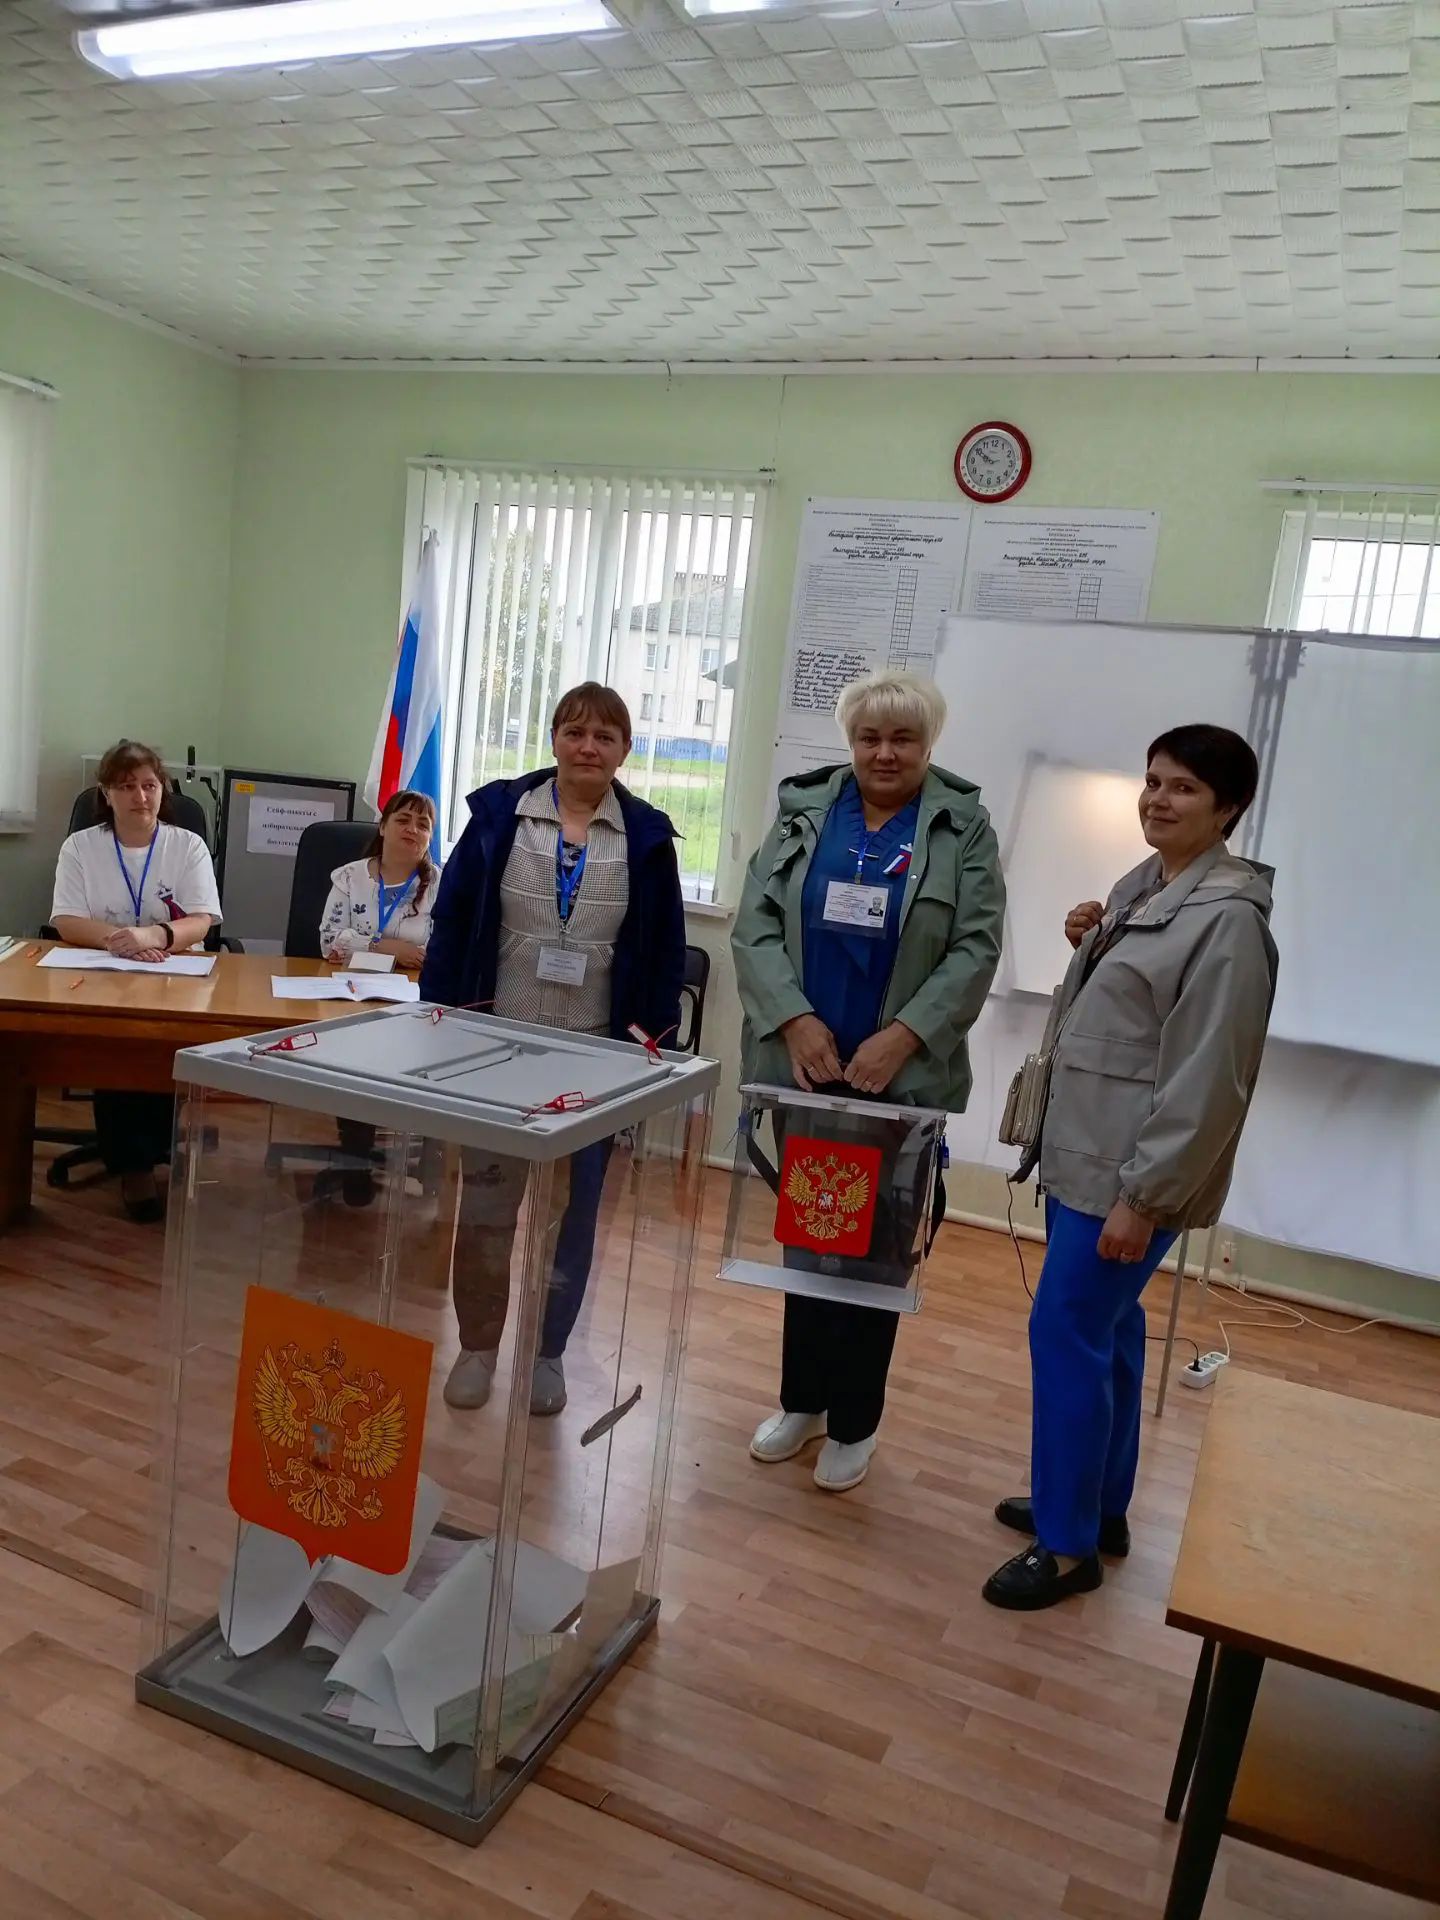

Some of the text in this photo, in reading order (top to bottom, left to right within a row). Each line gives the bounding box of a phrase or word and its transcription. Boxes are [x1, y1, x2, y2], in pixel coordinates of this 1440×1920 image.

[980, 474, 984, 482] 7
[996, 476, 1000, 484] 5
[267, 806, 312, 816] Сейф-пакеты
